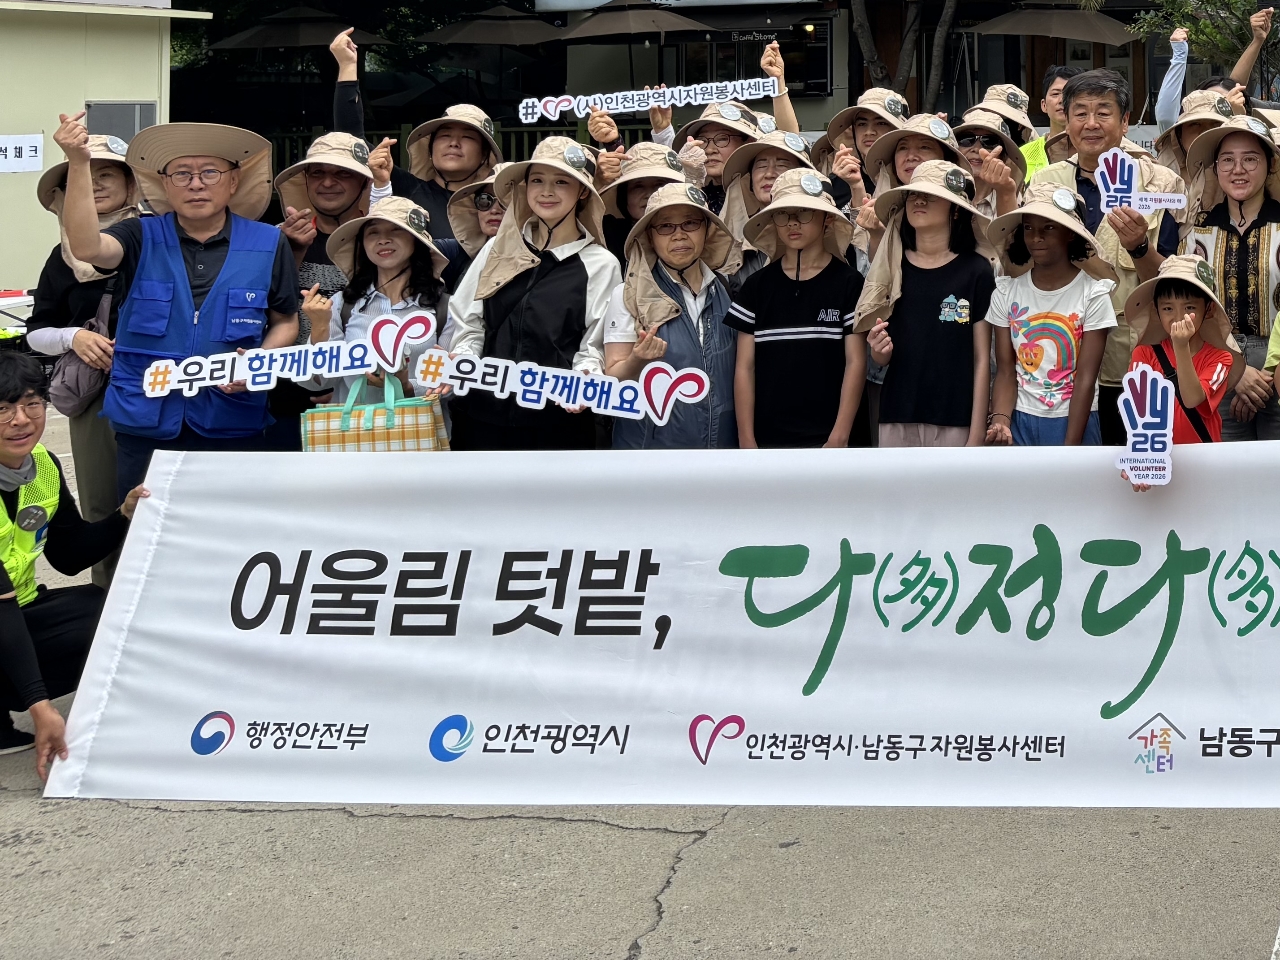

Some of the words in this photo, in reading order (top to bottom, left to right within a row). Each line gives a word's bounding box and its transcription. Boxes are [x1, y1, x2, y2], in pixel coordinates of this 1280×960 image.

[817, 308, 840, 321] AIR
[148, 357, 238, 392] #우리
[247, 343, 372, 386] 함께해요
[420, 354, 510, 392] #우리
[519, 367, 640, 414] 함께해요
[1131, 433, 1167, 452] 26
[229, 549, 473, 637] 어울림
[492, 548, 673, 650] 텃밭,
[246, 720, 370, 751] 행정안전부
[482, 723, 631, 755] 인천광역시
[1137, 728, 1172, 755] 가족
[1134, 748, 1174, 774] 센터
